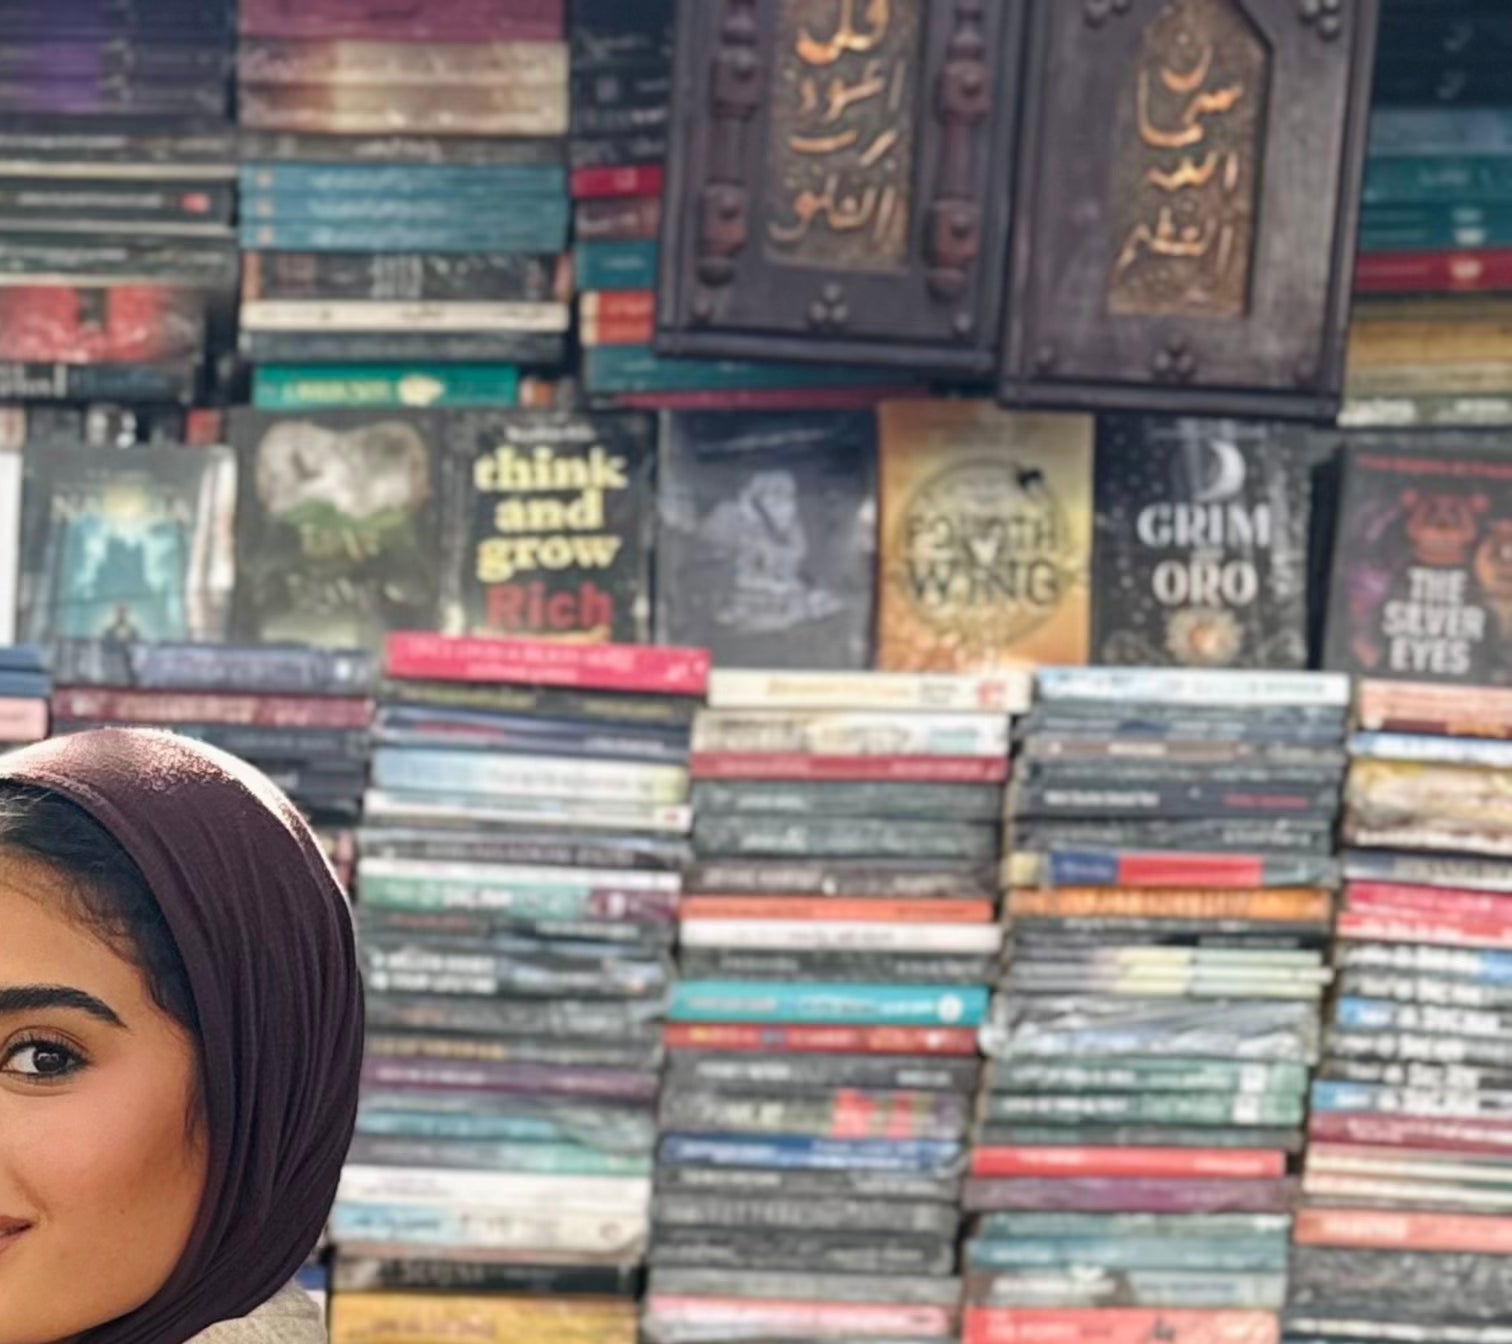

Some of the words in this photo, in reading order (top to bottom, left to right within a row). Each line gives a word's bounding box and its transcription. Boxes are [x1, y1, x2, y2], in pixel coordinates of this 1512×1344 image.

[474, 446, 628, 490] think
[494, 490, 603, 531] and
[1136, 501, 1272, 547] GRIM
[475, 537, 621, 582] grow
[1151, 558, 1259, 606] ORO
[906, 558, 1060, 607] WING
[1406, 566, 1468, 601] THE
[486, 583, 615, 630] Rich
[1389, 636, 1471, 675] EYES
